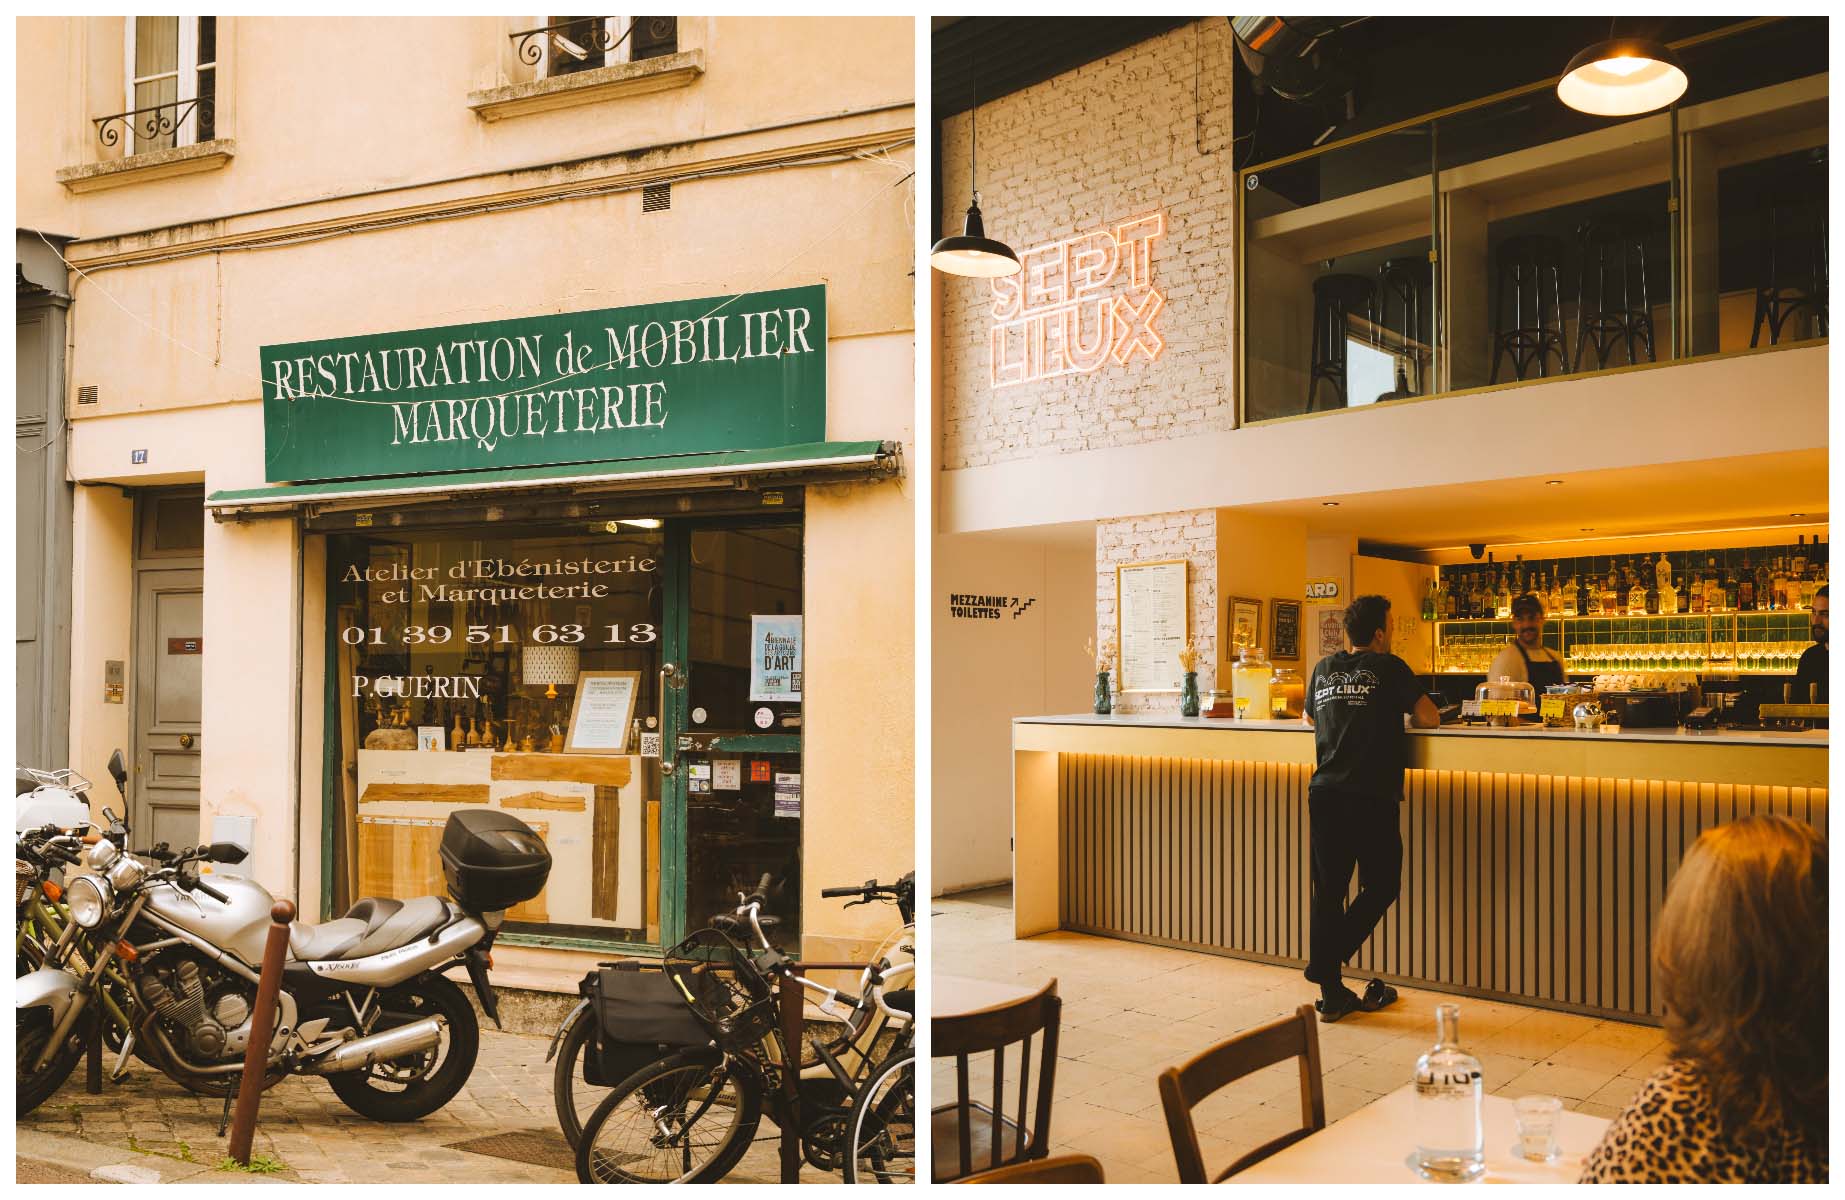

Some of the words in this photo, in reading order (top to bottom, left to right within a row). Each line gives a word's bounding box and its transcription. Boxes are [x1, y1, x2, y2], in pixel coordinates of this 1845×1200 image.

[271, 335, 543, 401] RESTAURATION
[555, 329, 593, 376] de
[604, 306, 815, 372] MOBILIER
[391, 380, 670, 452] MARQUETERIE
[134, 450, 145, 463] 17
[341, 562, 440, 583] Atelier
[448, 555, 657, 579] d'Ebénisterie
[381, 587, 410, 604] et
[419, 580, 610, 606] Marqueterie
[950, 593, 1008, 608] MEZZANINE
[950, 606, 1001, 619] TOILETTES
[342, 626, 387, 645] 01
[402, 625, 453, 645] 39
[465, 624, 514, 644] 51
[532, 623, 585, 644] 63
[603, 623, 657, 643] 13
[765, 656, 796, 671] D'ART
[351, 674, 483, 700] P.GUERIN
